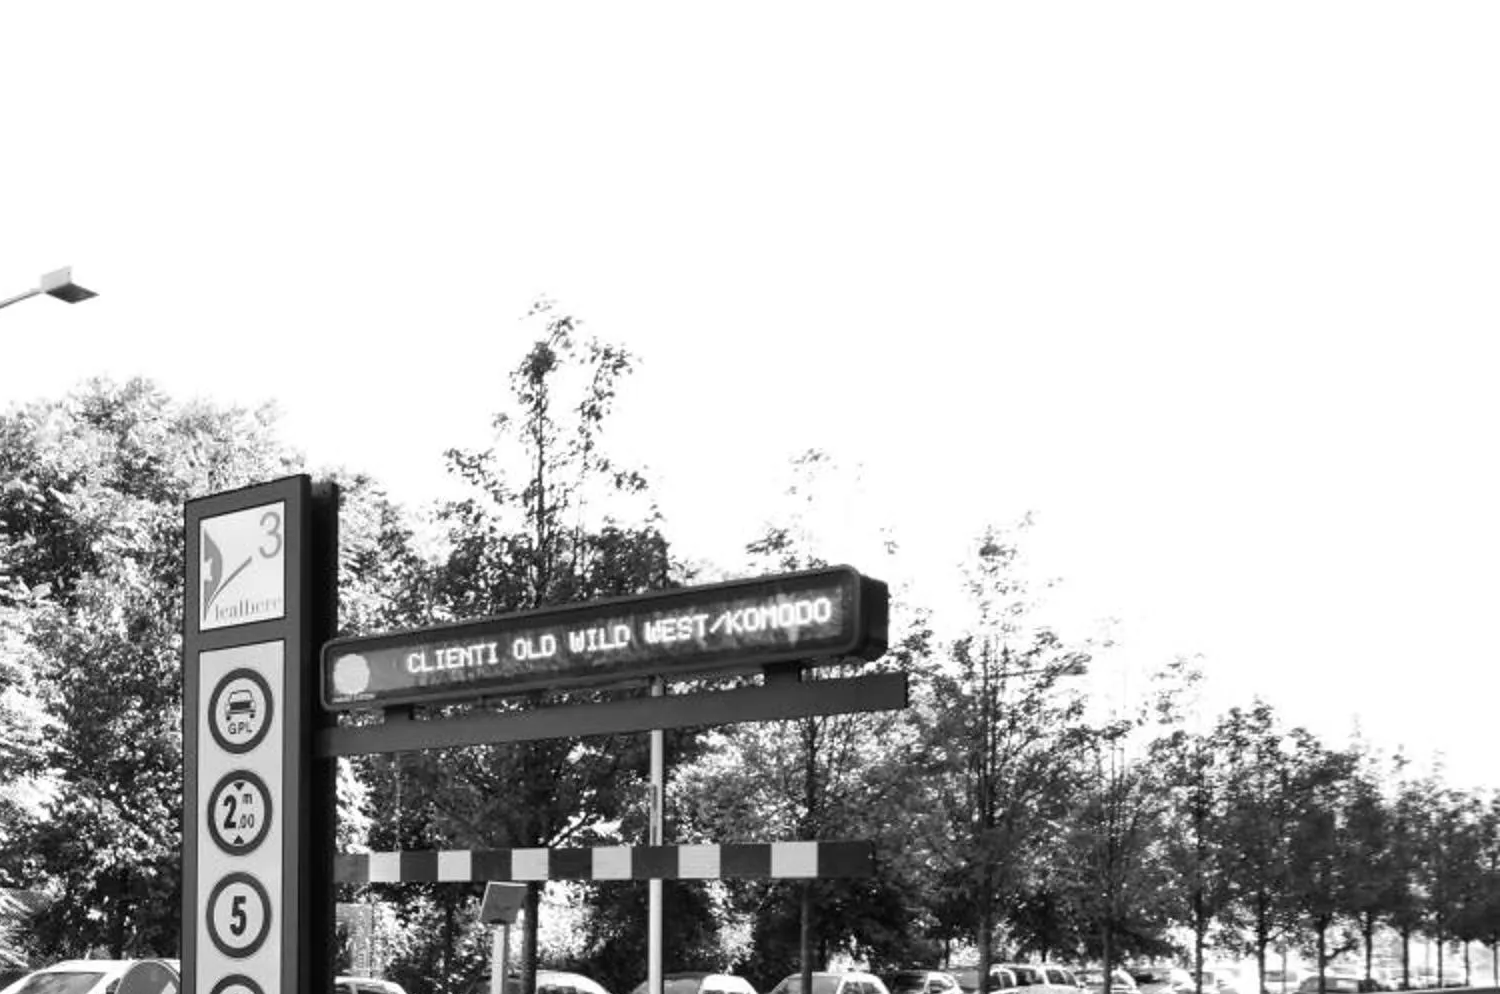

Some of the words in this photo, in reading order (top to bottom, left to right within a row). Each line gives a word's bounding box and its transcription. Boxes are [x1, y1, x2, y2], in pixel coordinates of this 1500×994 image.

[259, 511, 283, 559] 3
[406, 642, 498, 673] CLIENTI
[513, 633, 557, 661] OLD
[569, 624, 631, 654] WILD
[227, 721, 253, 735] GPL
[230, 895, 247, 936] 5
